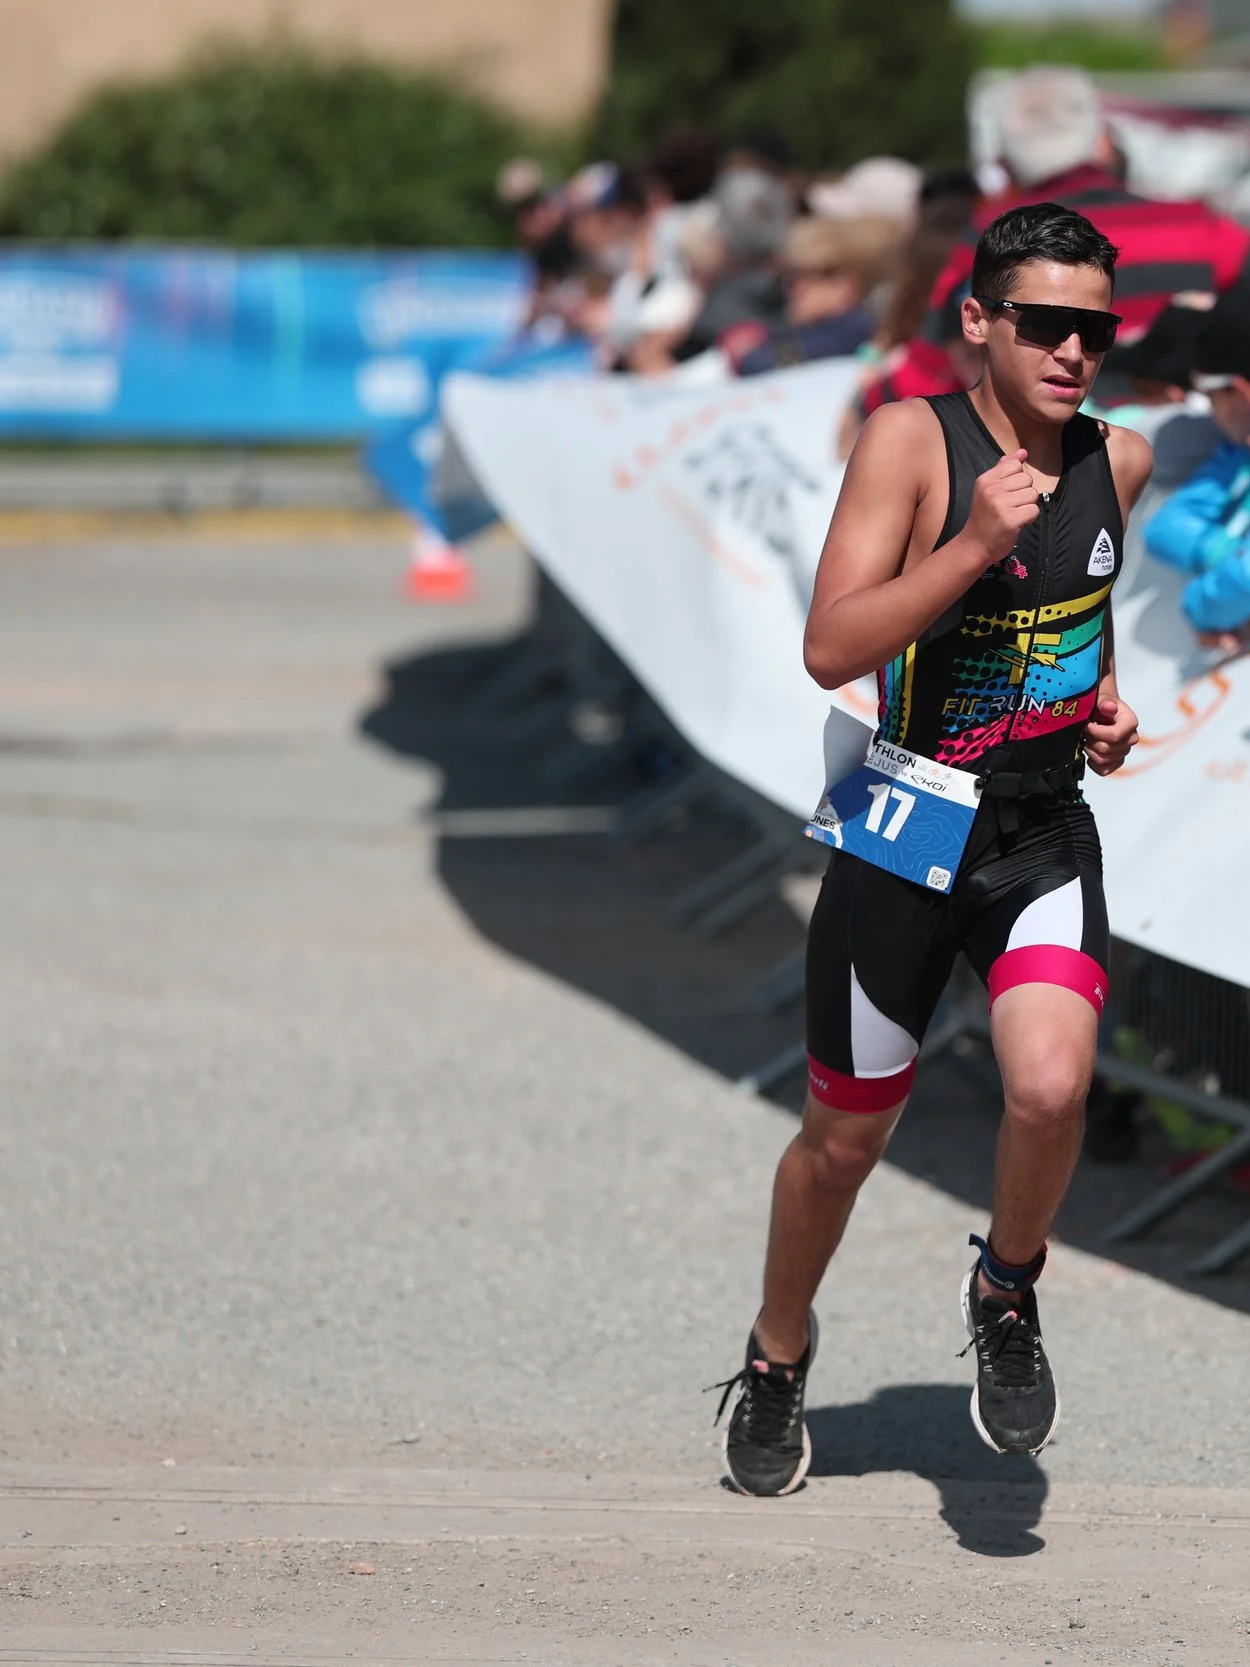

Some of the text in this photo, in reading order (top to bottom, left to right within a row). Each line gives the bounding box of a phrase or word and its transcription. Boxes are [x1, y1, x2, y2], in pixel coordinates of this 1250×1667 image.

[1093, 556, 1112, 564] AKENA
[941, 694, 1079, 717] FIT RUN 84
[865, 783, 916, 842] 17
